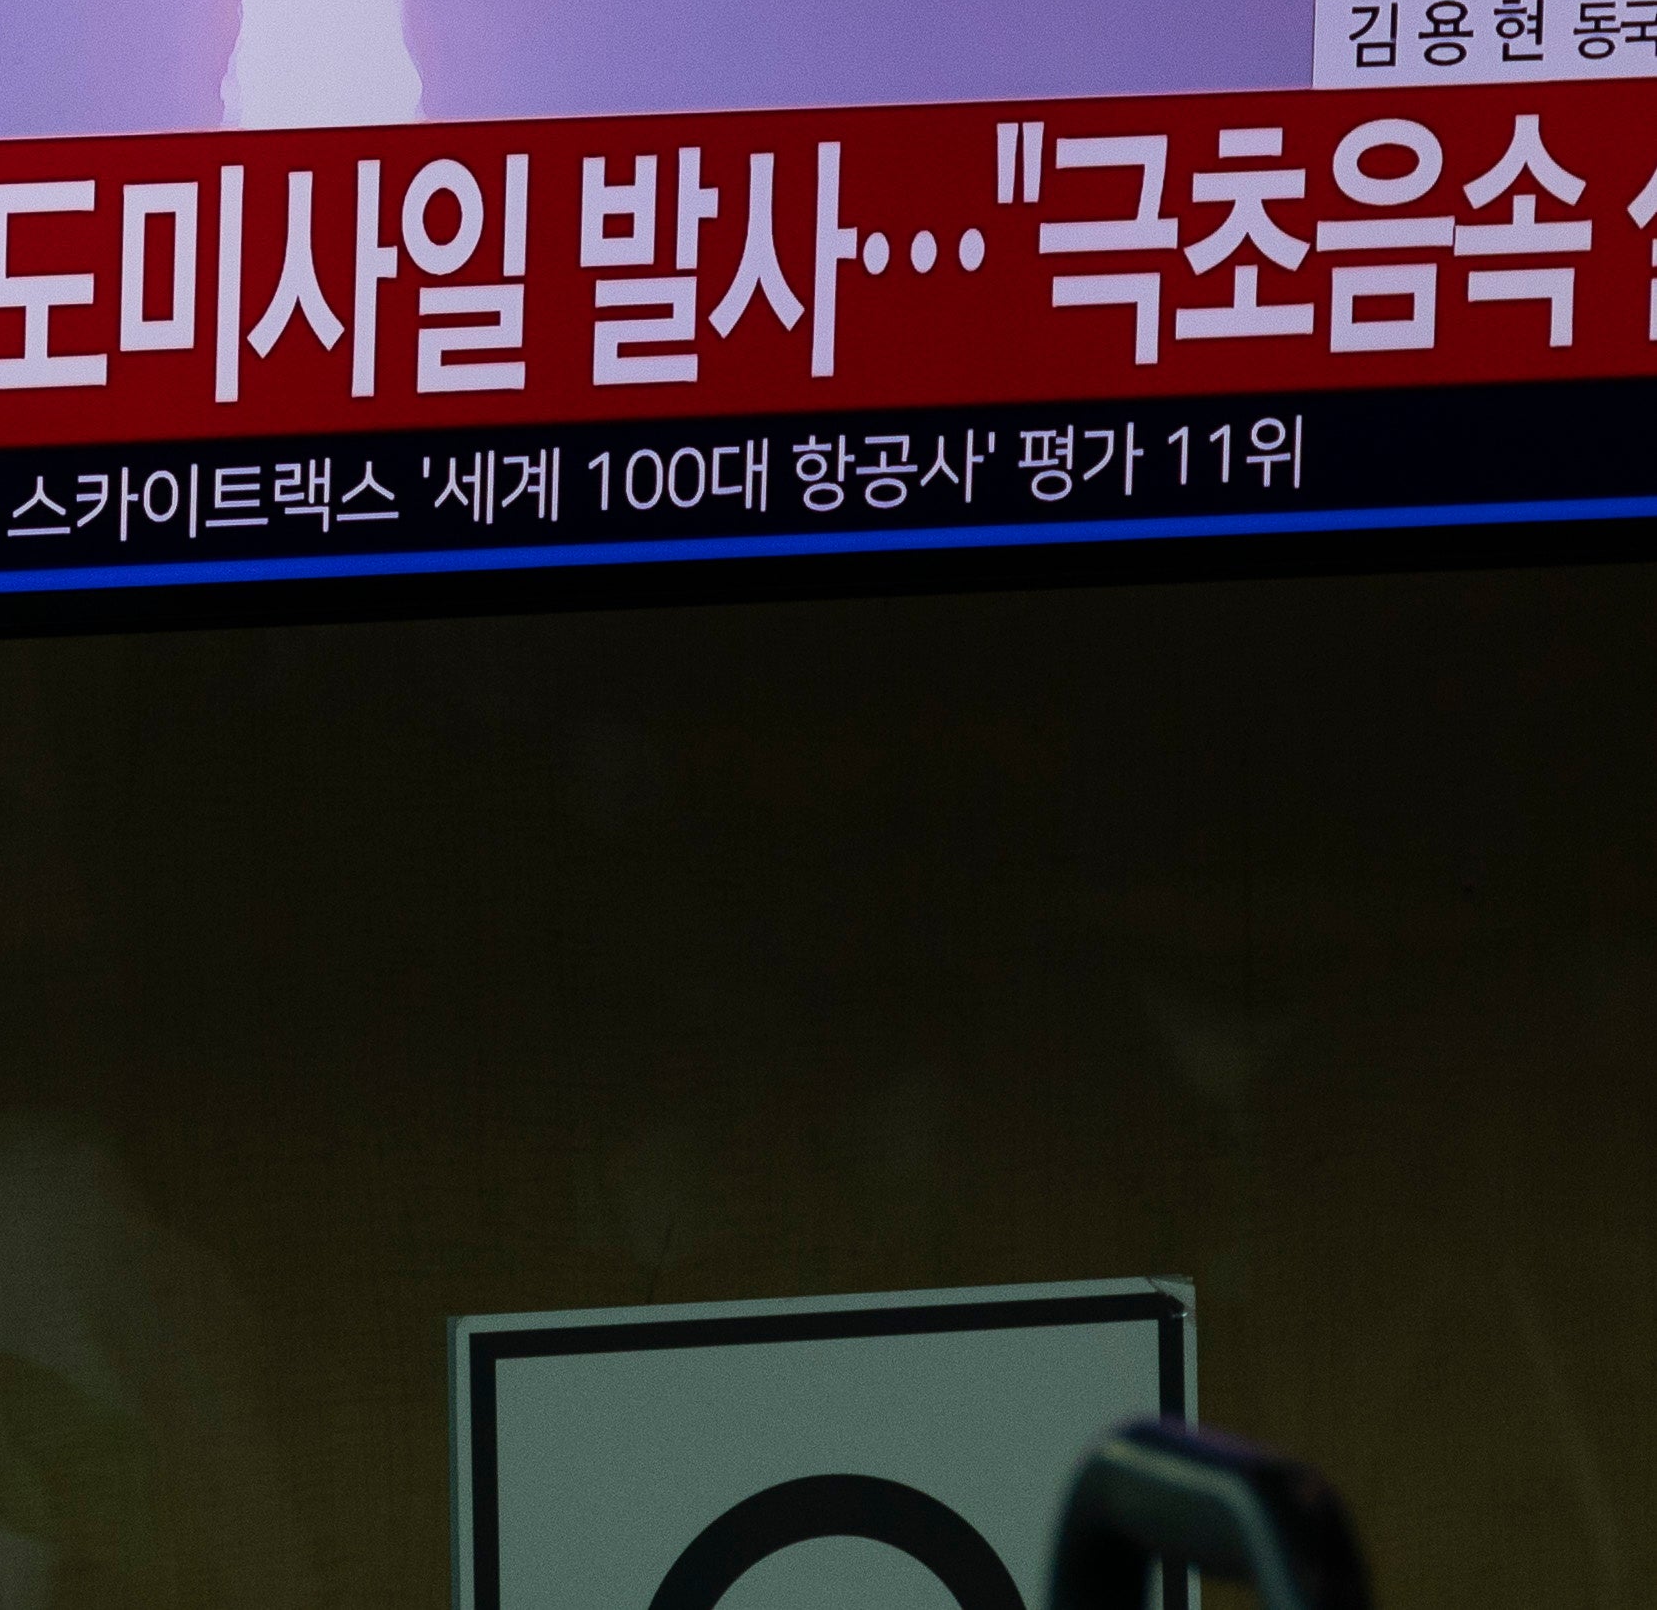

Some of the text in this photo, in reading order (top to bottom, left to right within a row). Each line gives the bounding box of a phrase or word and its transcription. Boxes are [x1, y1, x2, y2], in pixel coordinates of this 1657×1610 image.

[7, 457, 400, 541] 스카이트랙스
[422, 447, 560, 524] '세계
[588, 437, 769, 513] 100대
[792, 429, 996, 511] 항공사'
[1018, 421, 1145, 502] 평가
[1168, 414, 1303, 489] 11위
